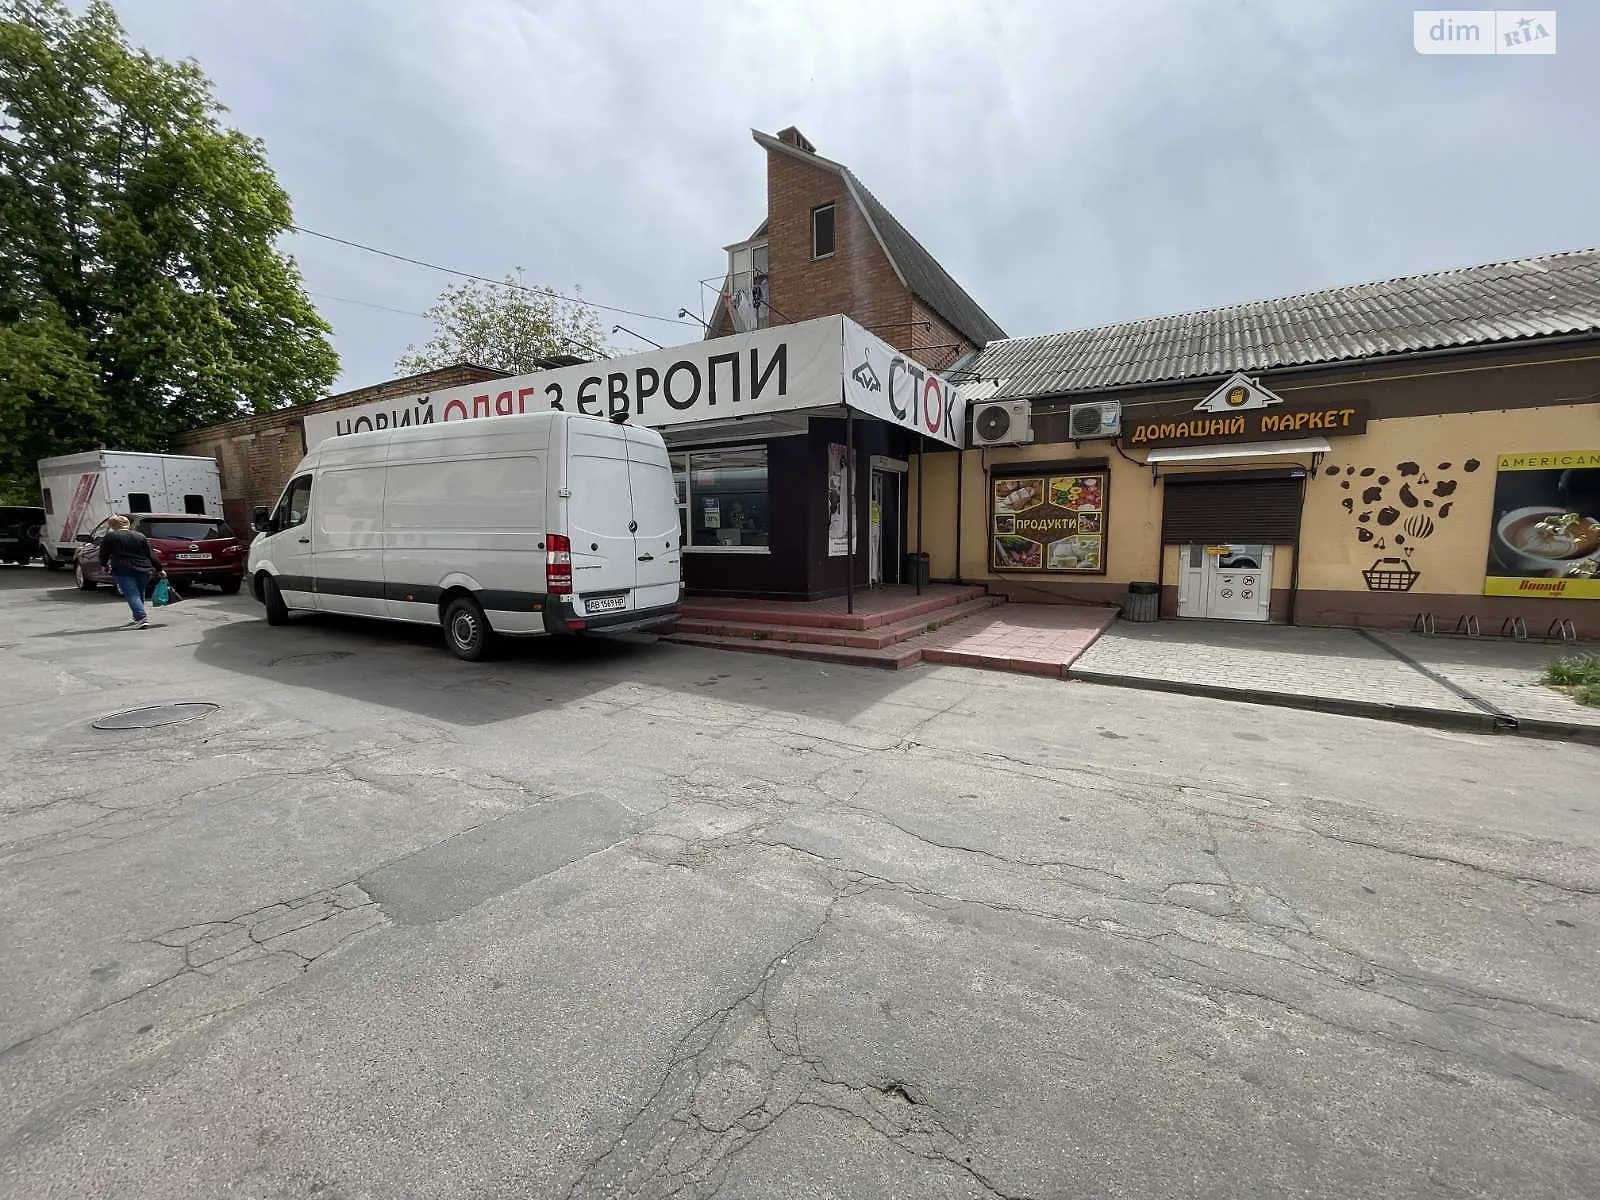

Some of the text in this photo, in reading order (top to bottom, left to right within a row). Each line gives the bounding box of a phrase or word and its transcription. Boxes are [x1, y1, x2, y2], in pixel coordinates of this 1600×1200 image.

[577, 343, 788, 417] ЄВРОПИ
[888, 355, 957, 442] СТОК
[1131, 408, 1355, 443] ДОМАШНІЙ МАРКЕТ
[1500, 455, 1600, 467] AMERICAN
[1016, 518, 1077, 531] ПРОДУКТИ
